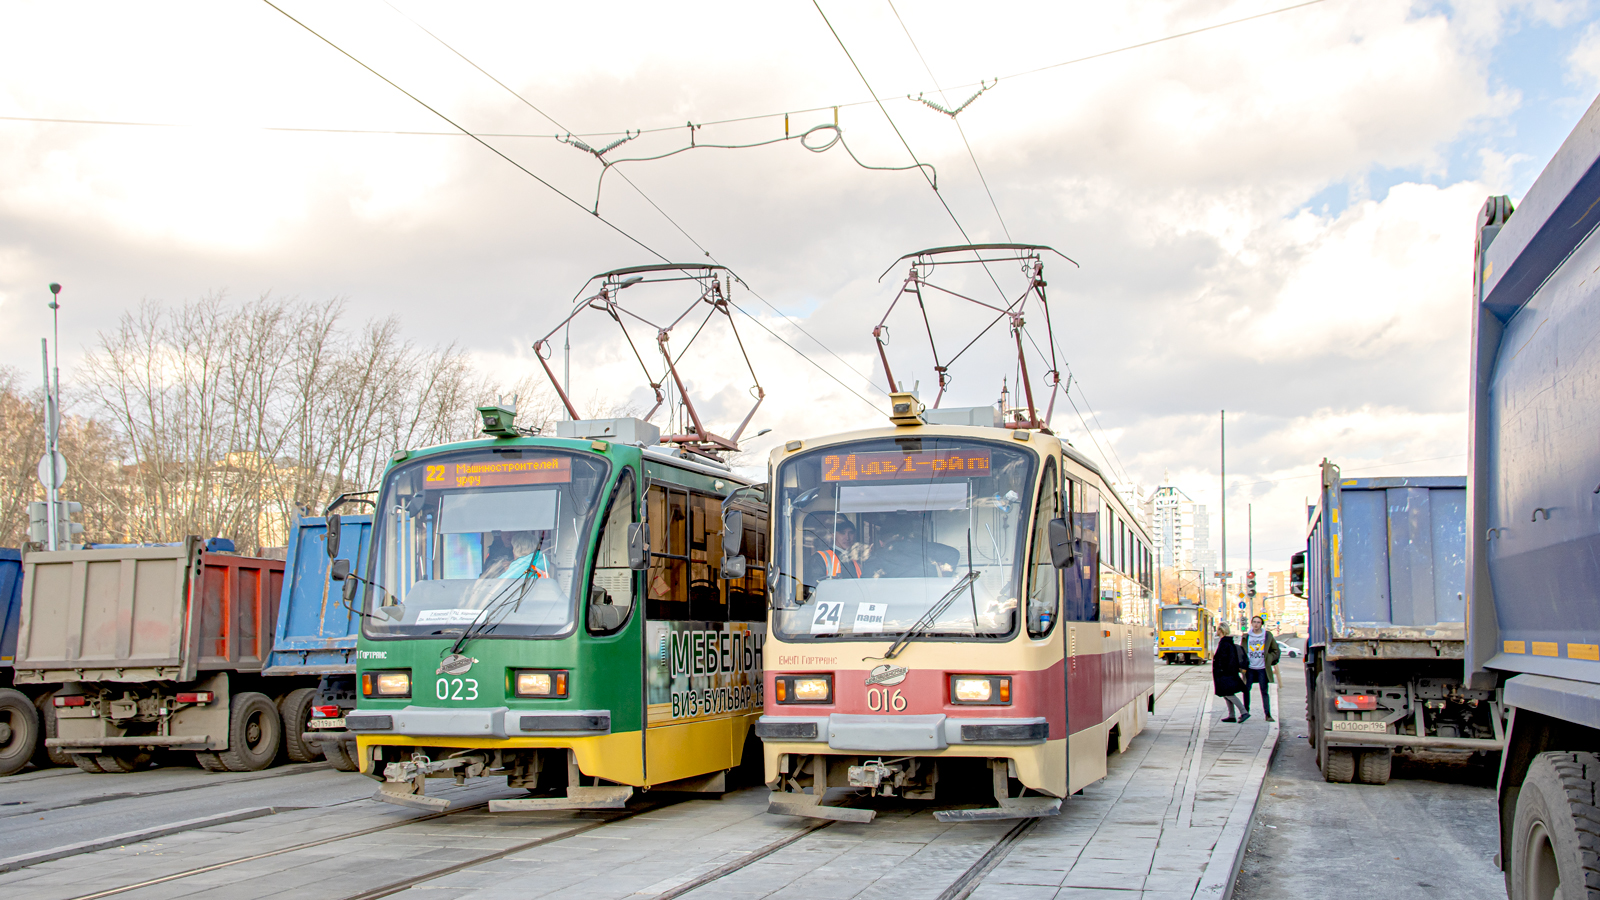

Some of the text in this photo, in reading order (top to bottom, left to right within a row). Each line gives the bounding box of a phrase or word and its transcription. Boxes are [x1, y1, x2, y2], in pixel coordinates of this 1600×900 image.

[426, 464, 445, 482] 22
[456, 458, 559, 474] Машиностроителей
[825, 454, 858, 480] 24
[814, 603, 841, 625] 24
[857, 614, 883, 623] парк
[671, 631, 766, 679] МЕБЕЛЬН
[436, 678, 479, 700] 023
[867, 688, 907, 712] 016
[672, 685, 754, 719] ВИЗ-БУЛЬВАР,
